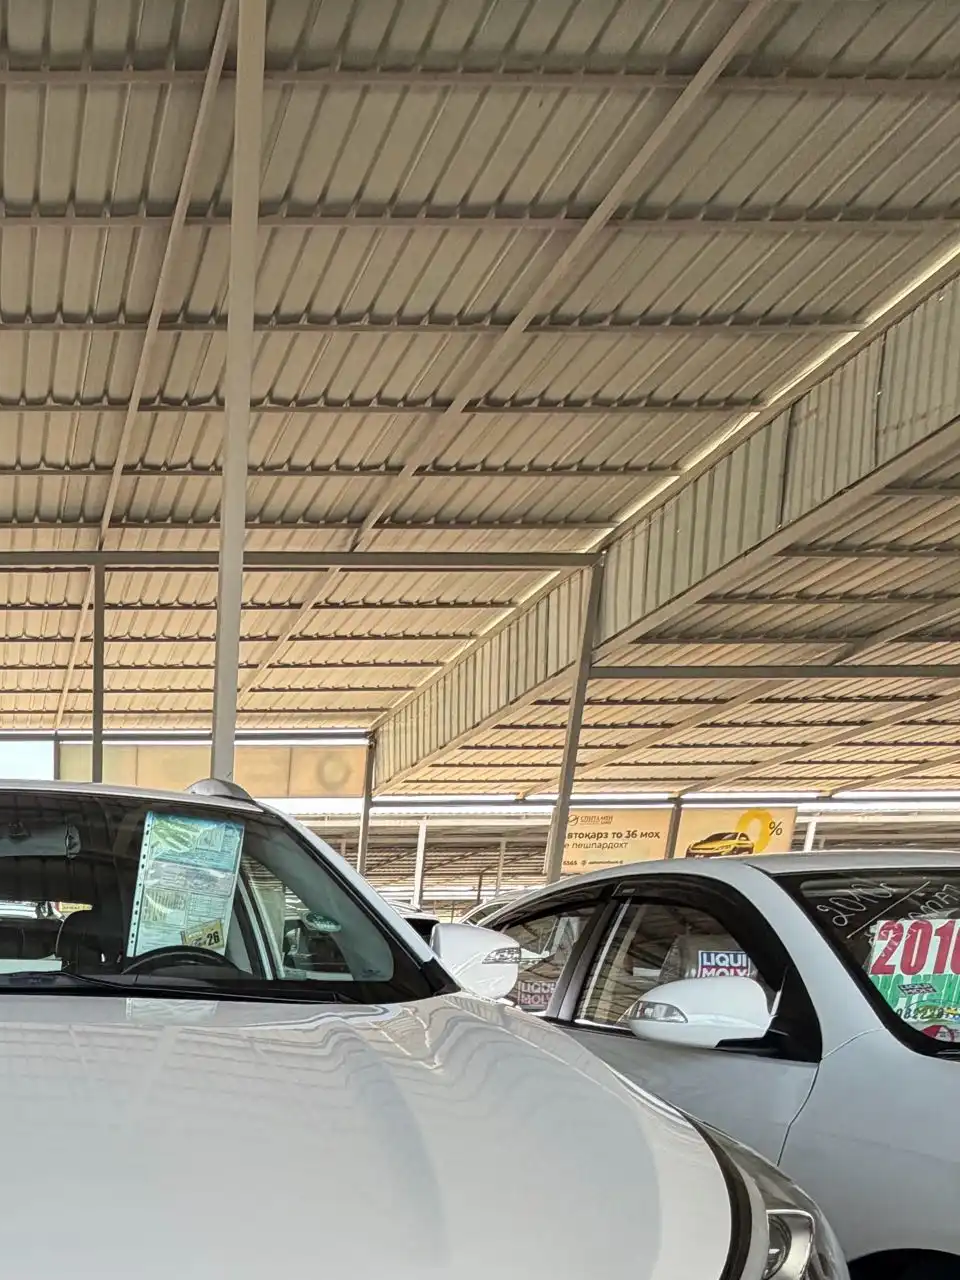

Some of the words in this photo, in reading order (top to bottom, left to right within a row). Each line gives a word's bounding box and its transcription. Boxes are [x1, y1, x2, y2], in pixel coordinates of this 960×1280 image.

[566, 831, 609, 841] втоқарз
[612, 831, 623, 839] то
[625, 829, 638, 839] 36
[702, 952, 747, 967] LIQUI
